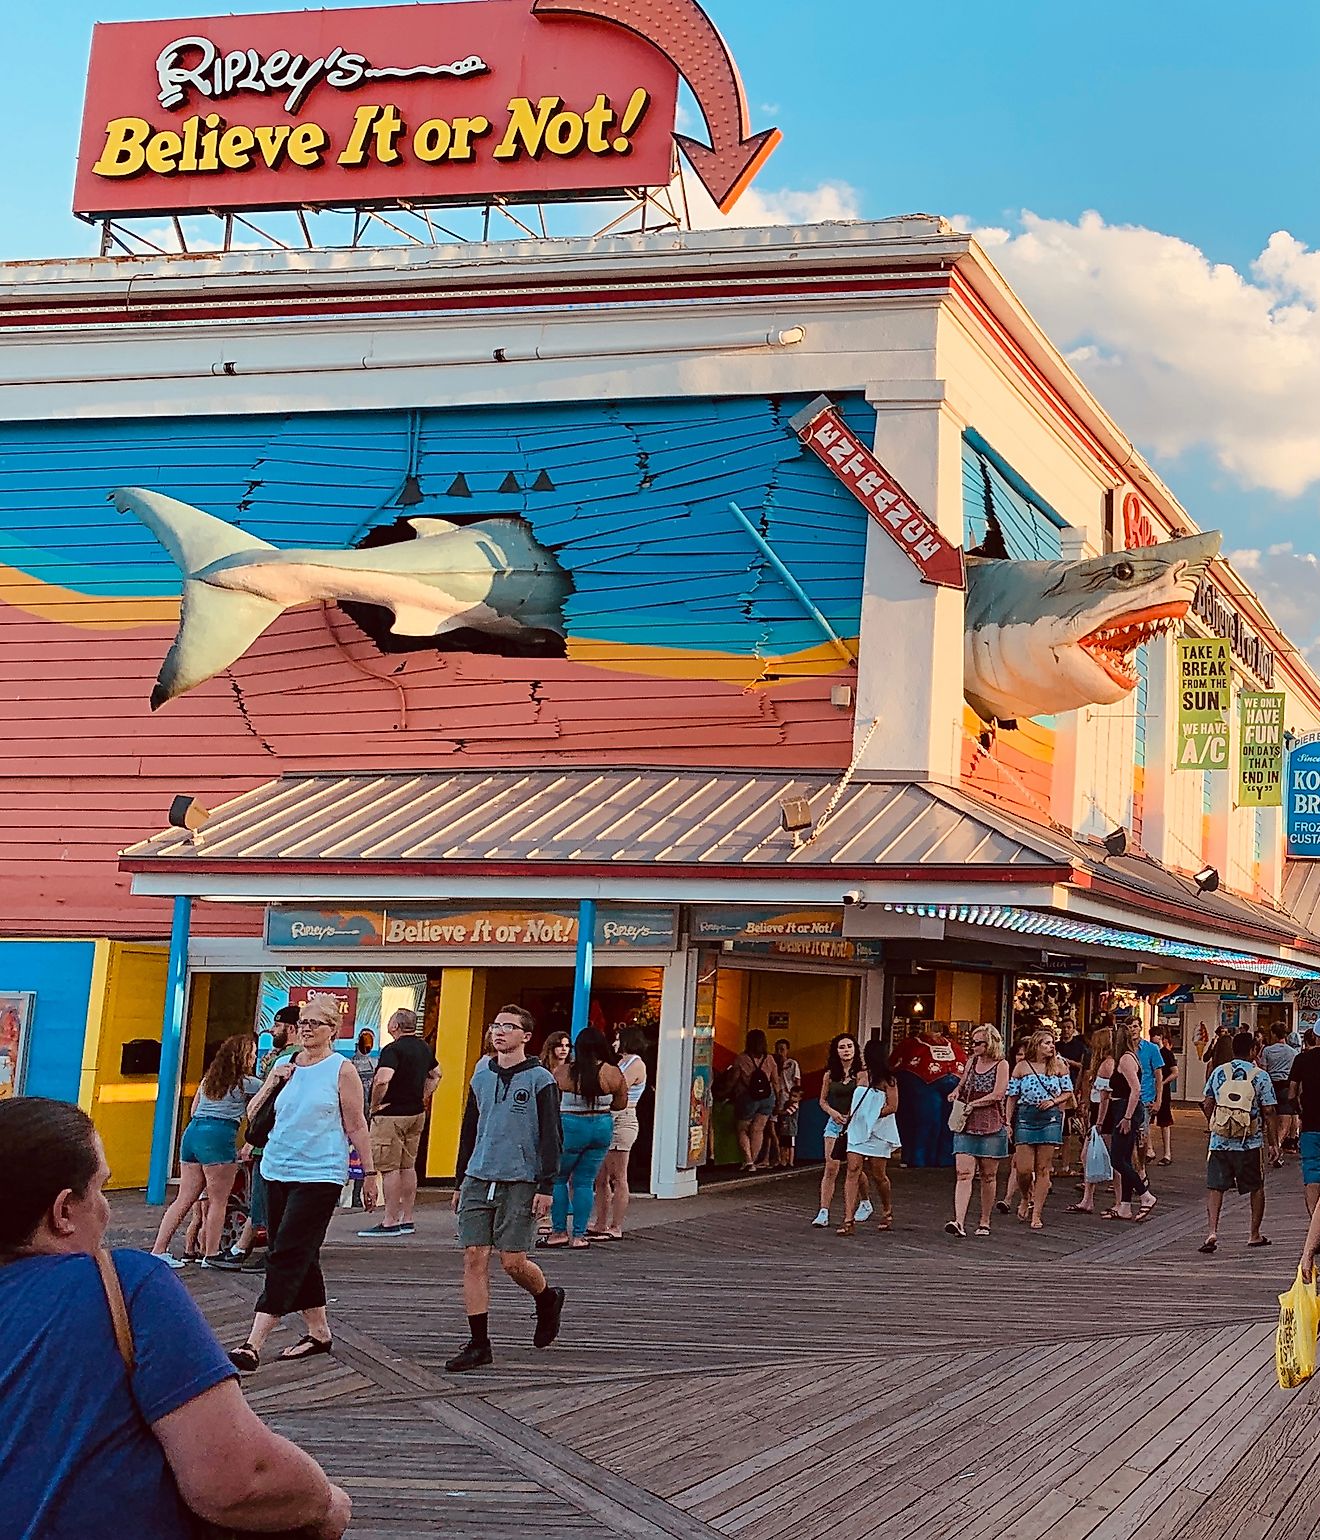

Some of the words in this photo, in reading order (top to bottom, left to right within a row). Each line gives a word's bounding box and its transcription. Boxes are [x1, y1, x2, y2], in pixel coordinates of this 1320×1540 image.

[156, 36, 372, 112] Ripley's
[92, 116, 326, 178] Believe
[337, 103, 402, 166] It
[413, 114, 489, 162] or
[493, 87, 648, 158] Not!
[813, 422, 941, 562] ENTRANCE
[1182, 646, 1212, 659] TAKE
[1218, 645, 1226, 659] A
[1182, 661, 1226, 677] BREAK
[1182, 679, 1207, 688] FROM
[1211, 678, 1227, 688] THE
[1182, 691, 1227, 711] SUN.
[1244, 698, 1258, 708] WE
[1260, 697, 1282, 708] ONLY
[1246, 709, 1280, 724] HAVE
[1183, 723, 1199, 735] WE
[1201, 722, 1227, 735] HAVE
[1245, 725, 1279, 744] FUN
[1294, 733, 1316, 749] PIER
[1181, 736, 1226, 764] A/C
[1243, 746, 1254, 756] ON
[1257, 745, 1281, 756] DAYS
[1248, 758, 1274, 769] THAT
[1242, 771, 1265, 783] END
[1267, 771, 1279, 783] IN
[291, 921, 336, 940] Ripley's
[387, 919, 466, 943] Believe
[469, 919, 493, 943] It
[496, 925, 521, 943] or
[525, 918, 577, 943] Not!
[603, 921, 652, 940] Ripley's
[745, 922, 783, 934] Believe
[785, 922, 797, 934] It
[798, 924, 809, 934] or
[810, 922, 834, 934] Not!
[1201, 977, 1237, 991] ATM
[339, 1001, 350, 1014] It
